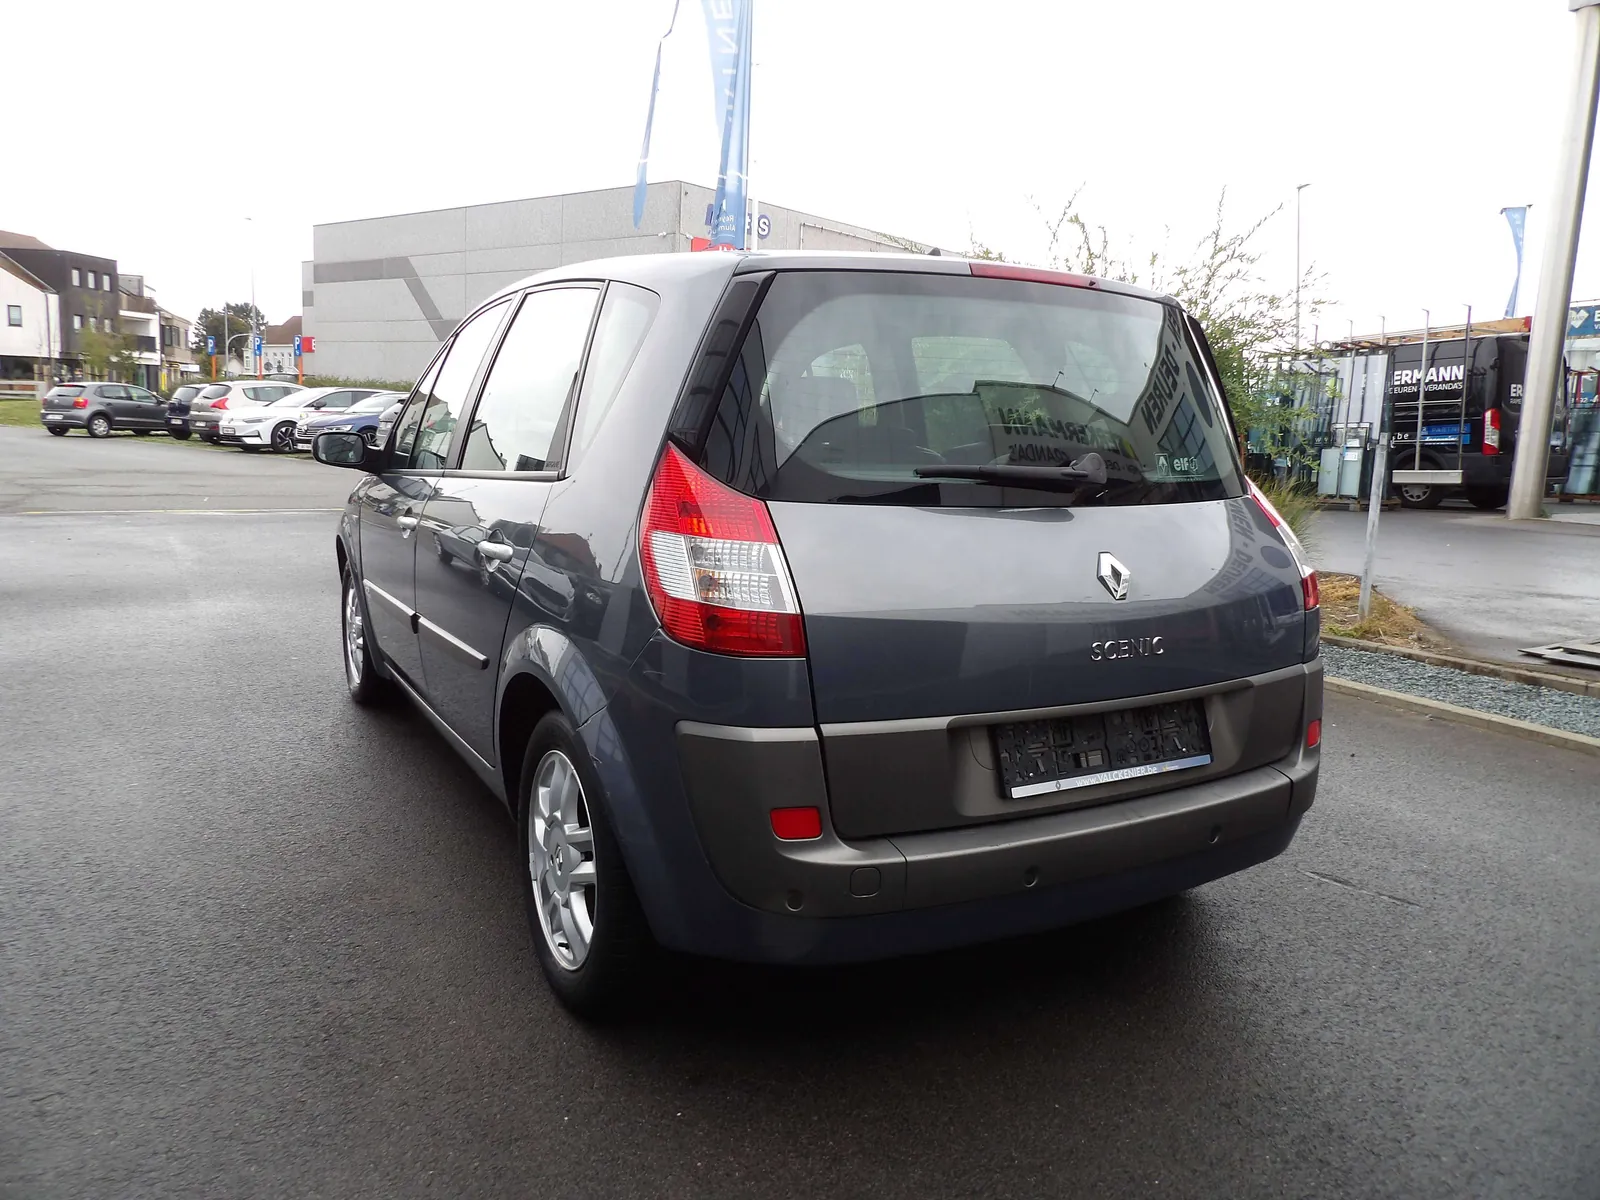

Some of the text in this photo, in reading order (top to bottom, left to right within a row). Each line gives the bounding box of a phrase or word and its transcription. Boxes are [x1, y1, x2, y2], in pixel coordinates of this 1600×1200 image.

[1393, 365, 1464, 385] ERMANN
[1173, 457, 1189, 471] elf
[1091, 635, 1164, 661] SCENIC
[1075, 765, 1158, 787] www.VALCKENIER.be
